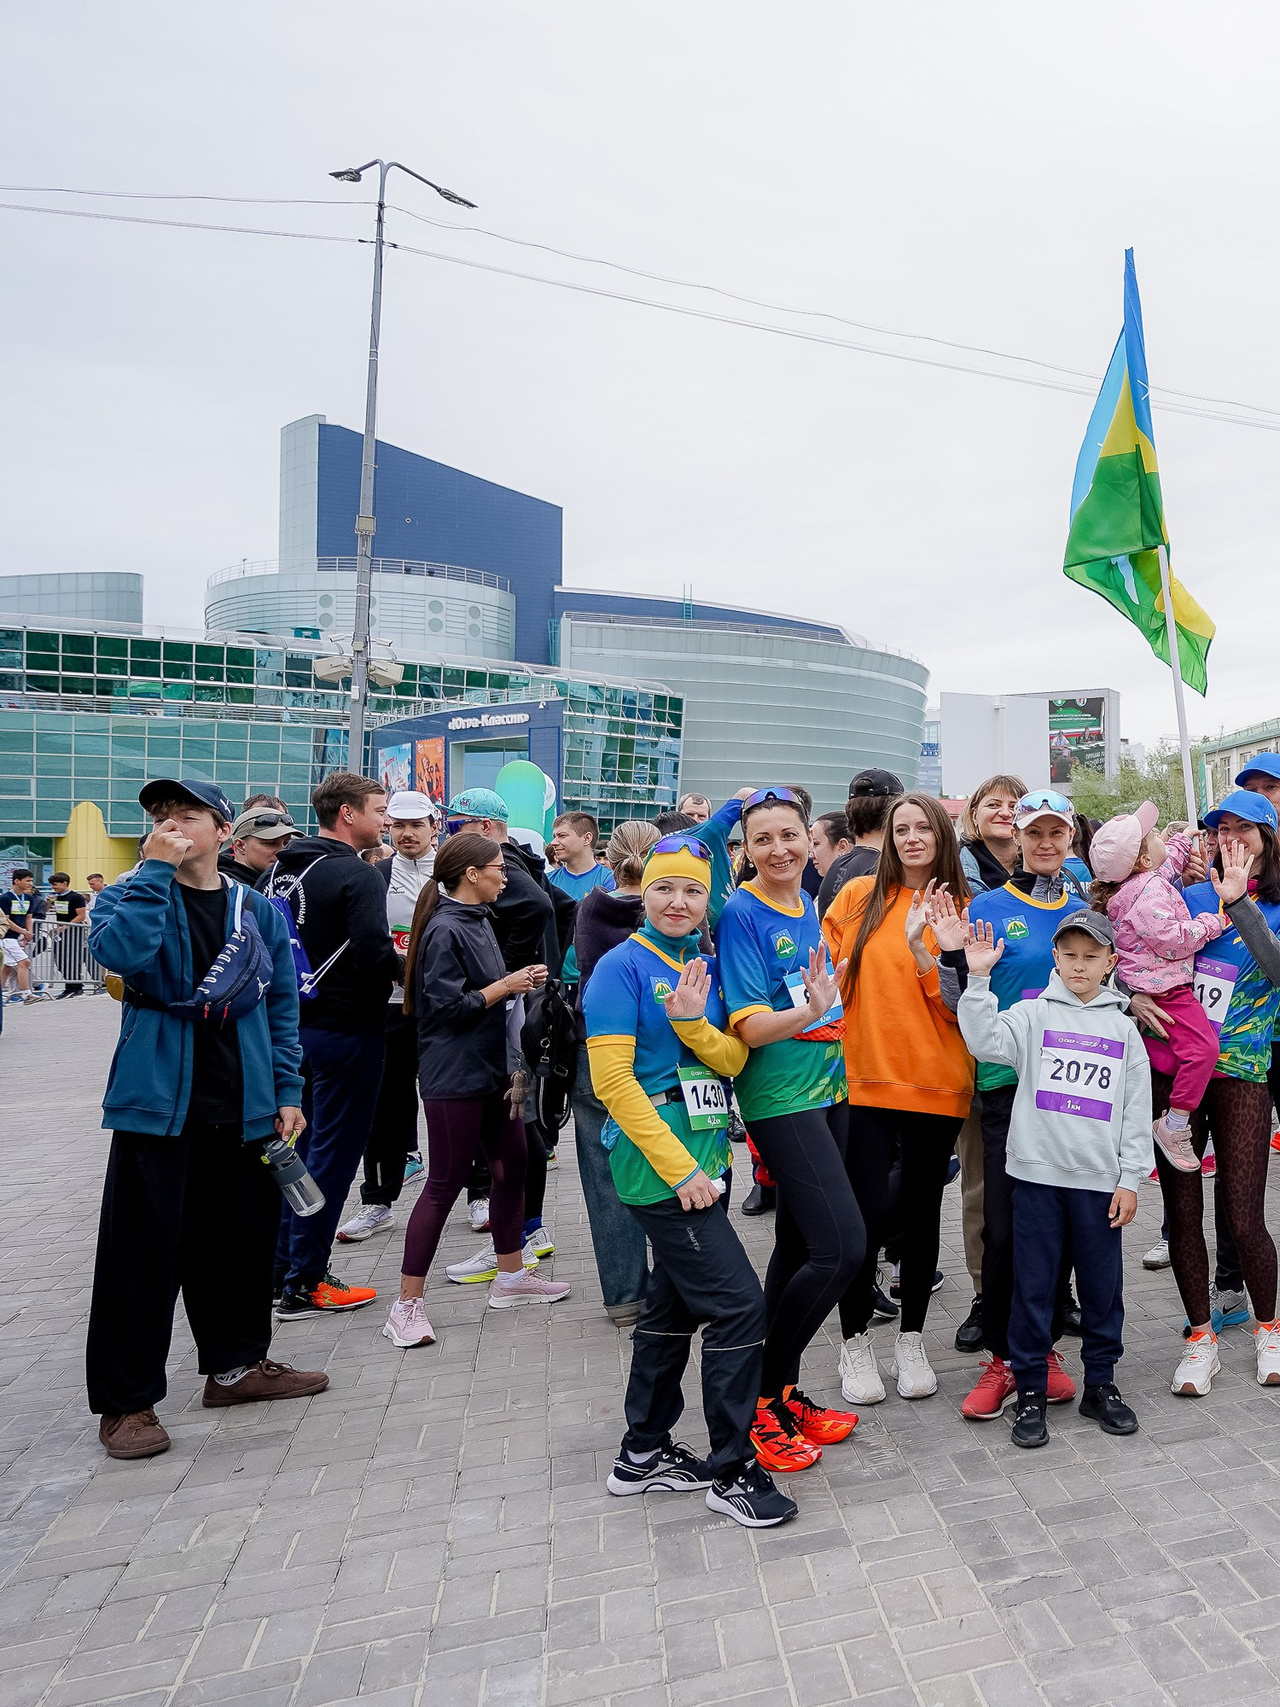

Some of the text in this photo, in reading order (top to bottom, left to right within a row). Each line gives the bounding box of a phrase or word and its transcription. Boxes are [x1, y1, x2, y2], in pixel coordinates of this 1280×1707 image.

[1196, 983, 1222, 1009] 19
[1050, 1058, 1112, 1090] 2078
[690, 1084, 724, 1109] 1430
